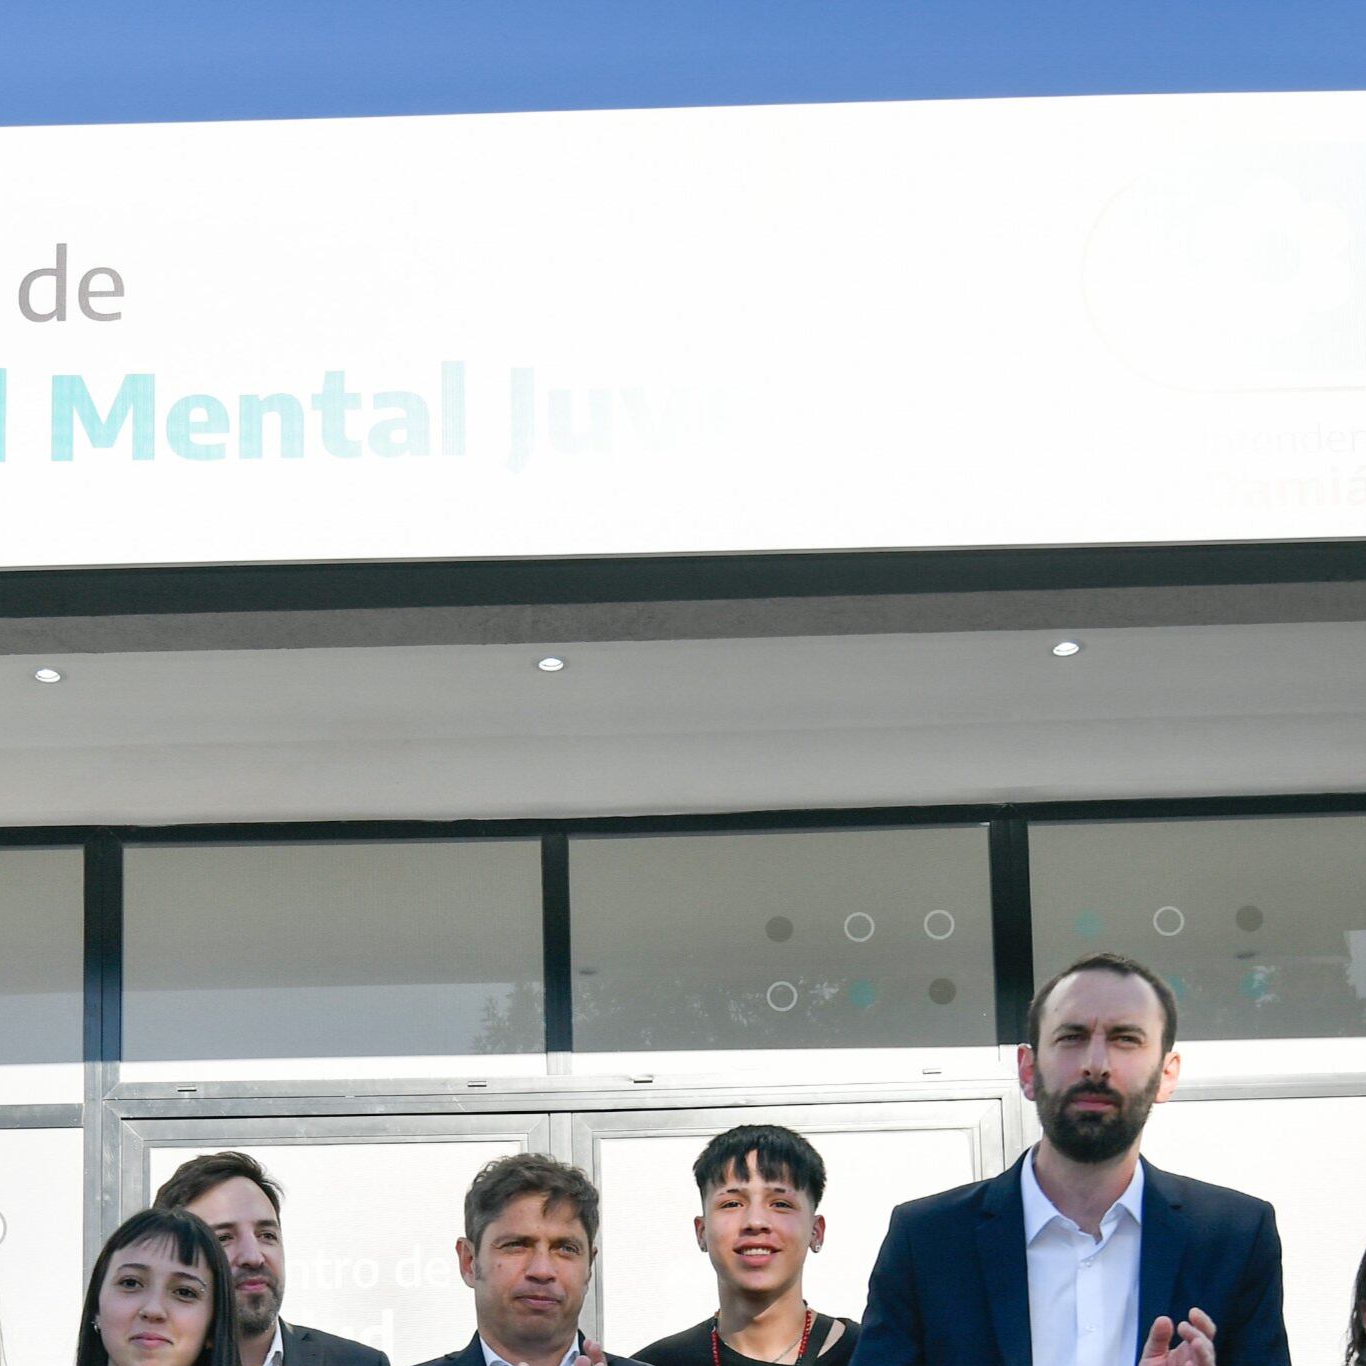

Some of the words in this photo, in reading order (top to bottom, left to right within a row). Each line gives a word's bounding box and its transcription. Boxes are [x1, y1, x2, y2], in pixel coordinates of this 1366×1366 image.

[19, 243, 125, 323] de
[51, 361, 466, 461] Mental
[394, 1244, 452, 1289] de
